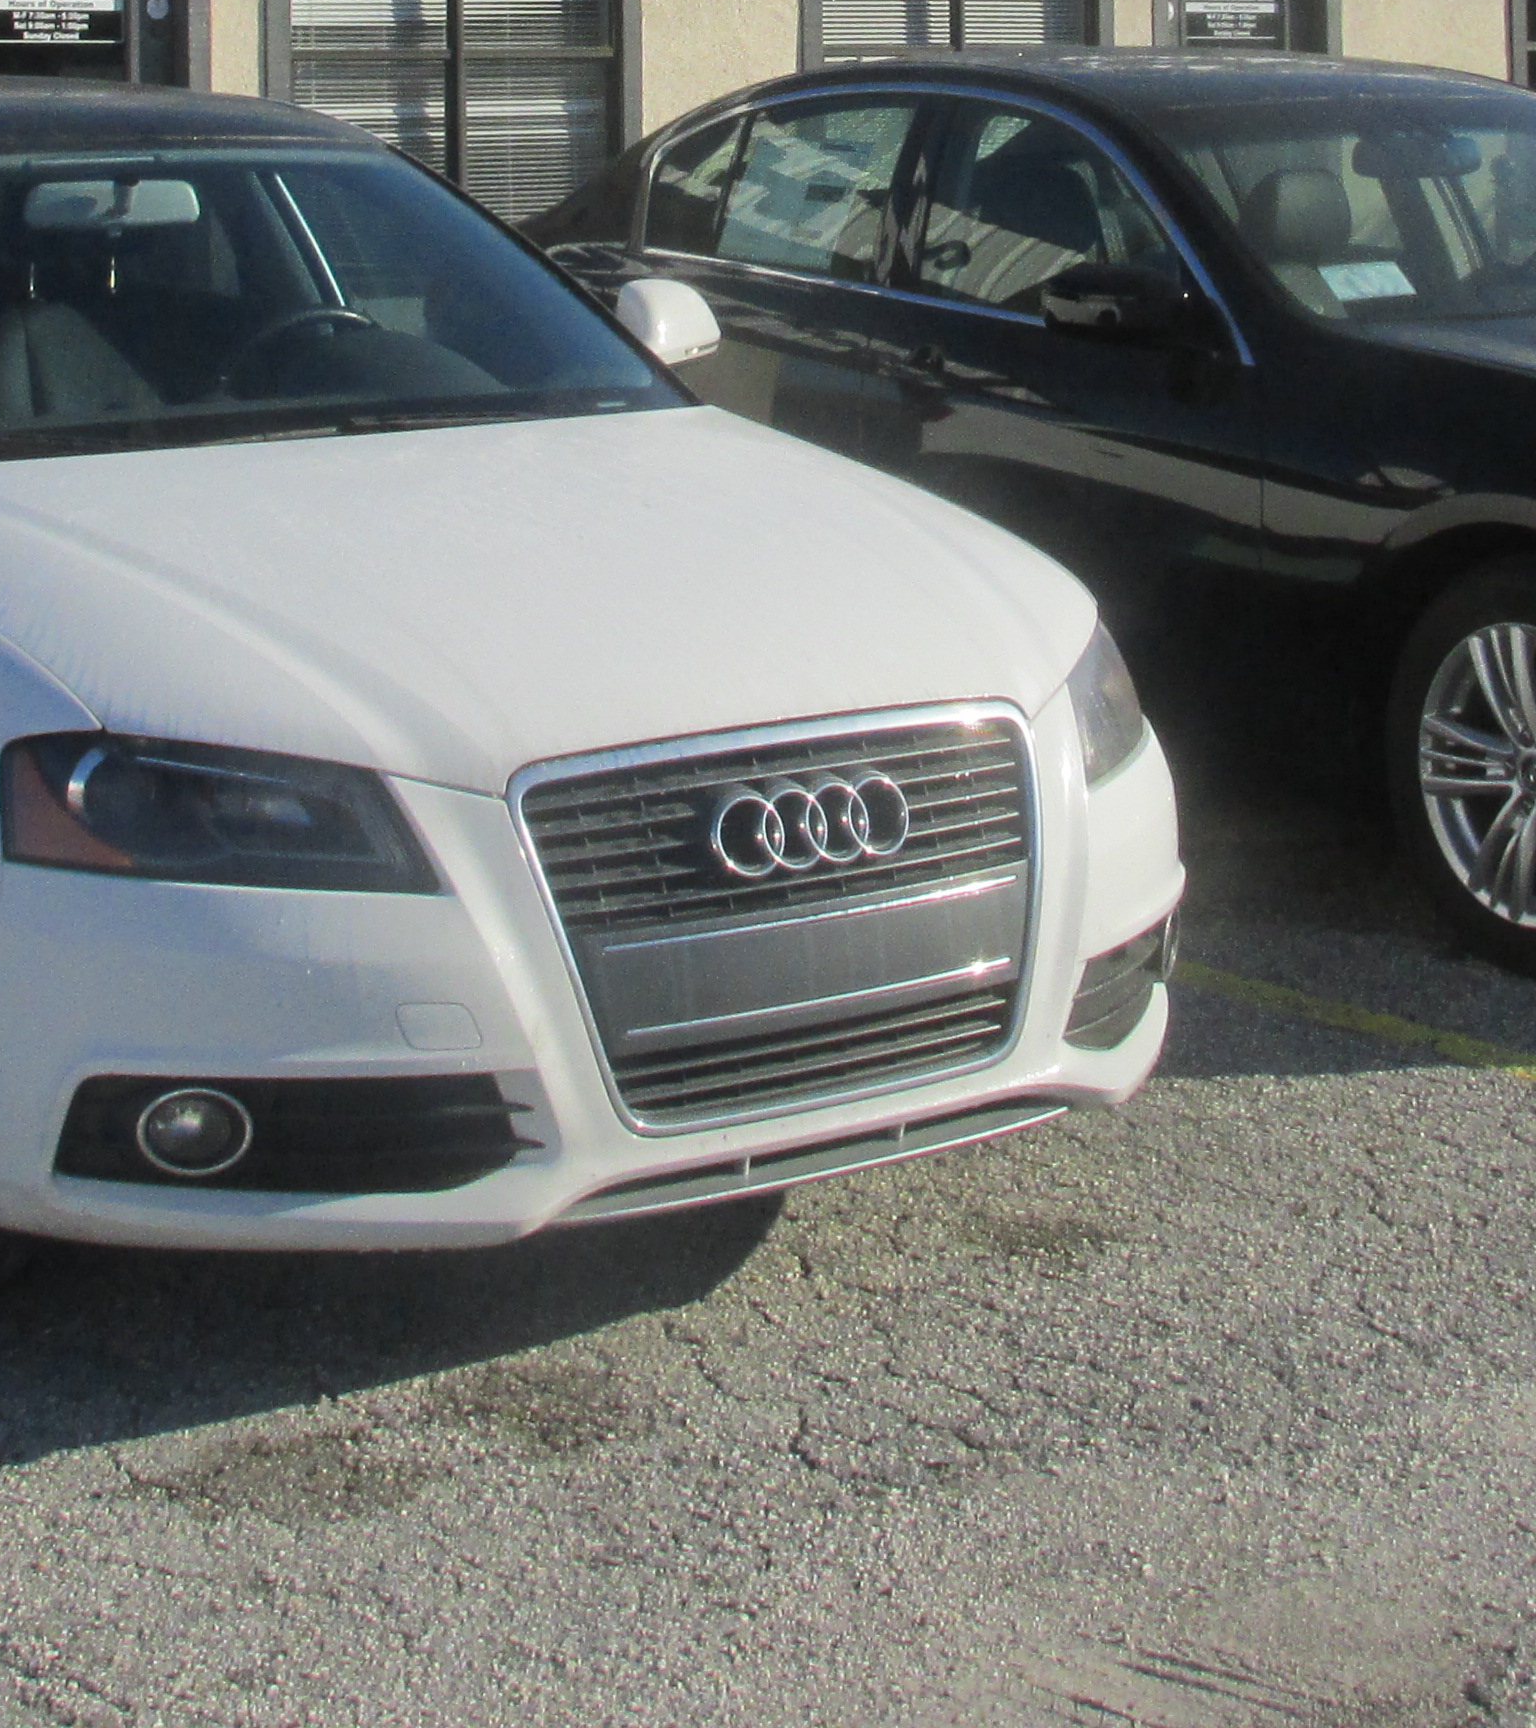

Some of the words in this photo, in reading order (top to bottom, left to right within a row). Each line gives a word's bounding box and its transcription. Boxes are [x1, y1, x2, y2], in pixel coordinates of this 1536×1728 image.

[8, 0, 36, 8] Hours
[37, 0, 47, 8] of
[49, 0, 95, 10] Operation
